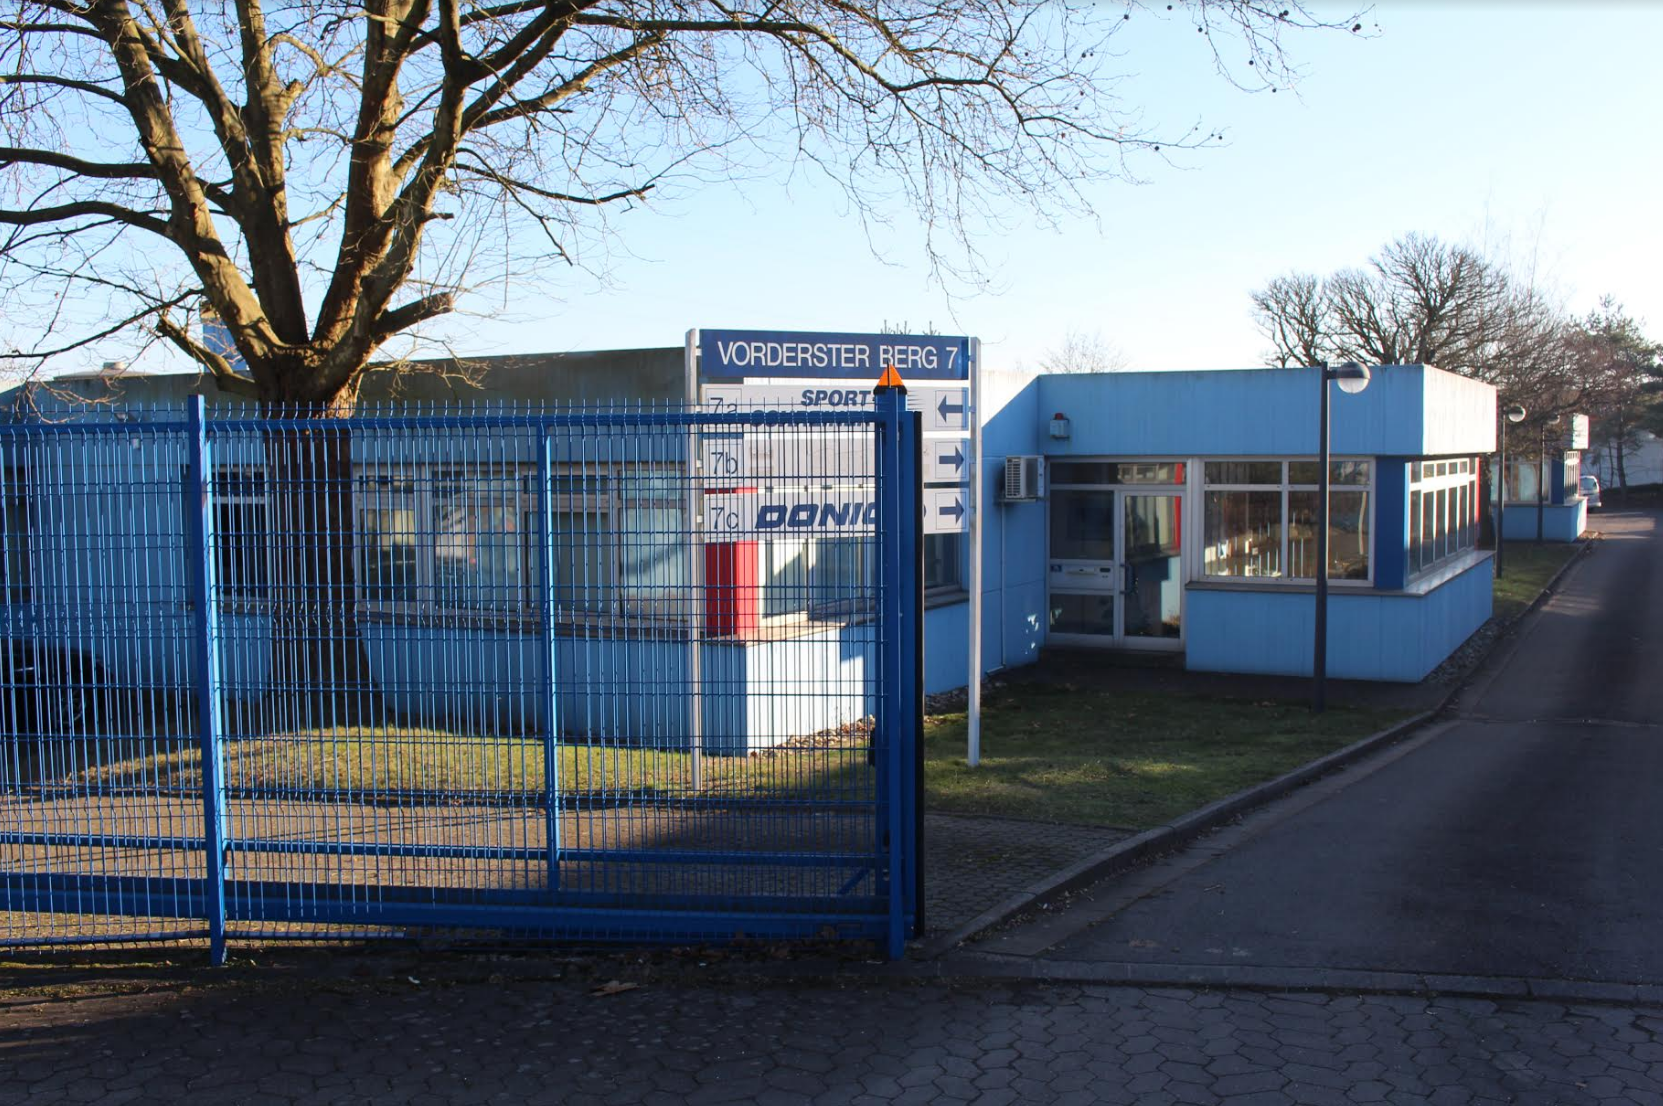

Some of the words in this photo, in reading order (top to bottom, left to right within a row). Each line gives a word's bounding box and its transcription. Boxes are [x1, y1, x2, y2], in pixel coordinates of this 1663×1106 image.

[717, 341, 870, 367] VORDERSTER
[879, 345, 938, 369] BERG
[945, 347, 958, 369] 7
[801, 389, 872, 407] SPORT
[711, 451, 738, 474] 7b
[711, 507, 738, 529] 7c
